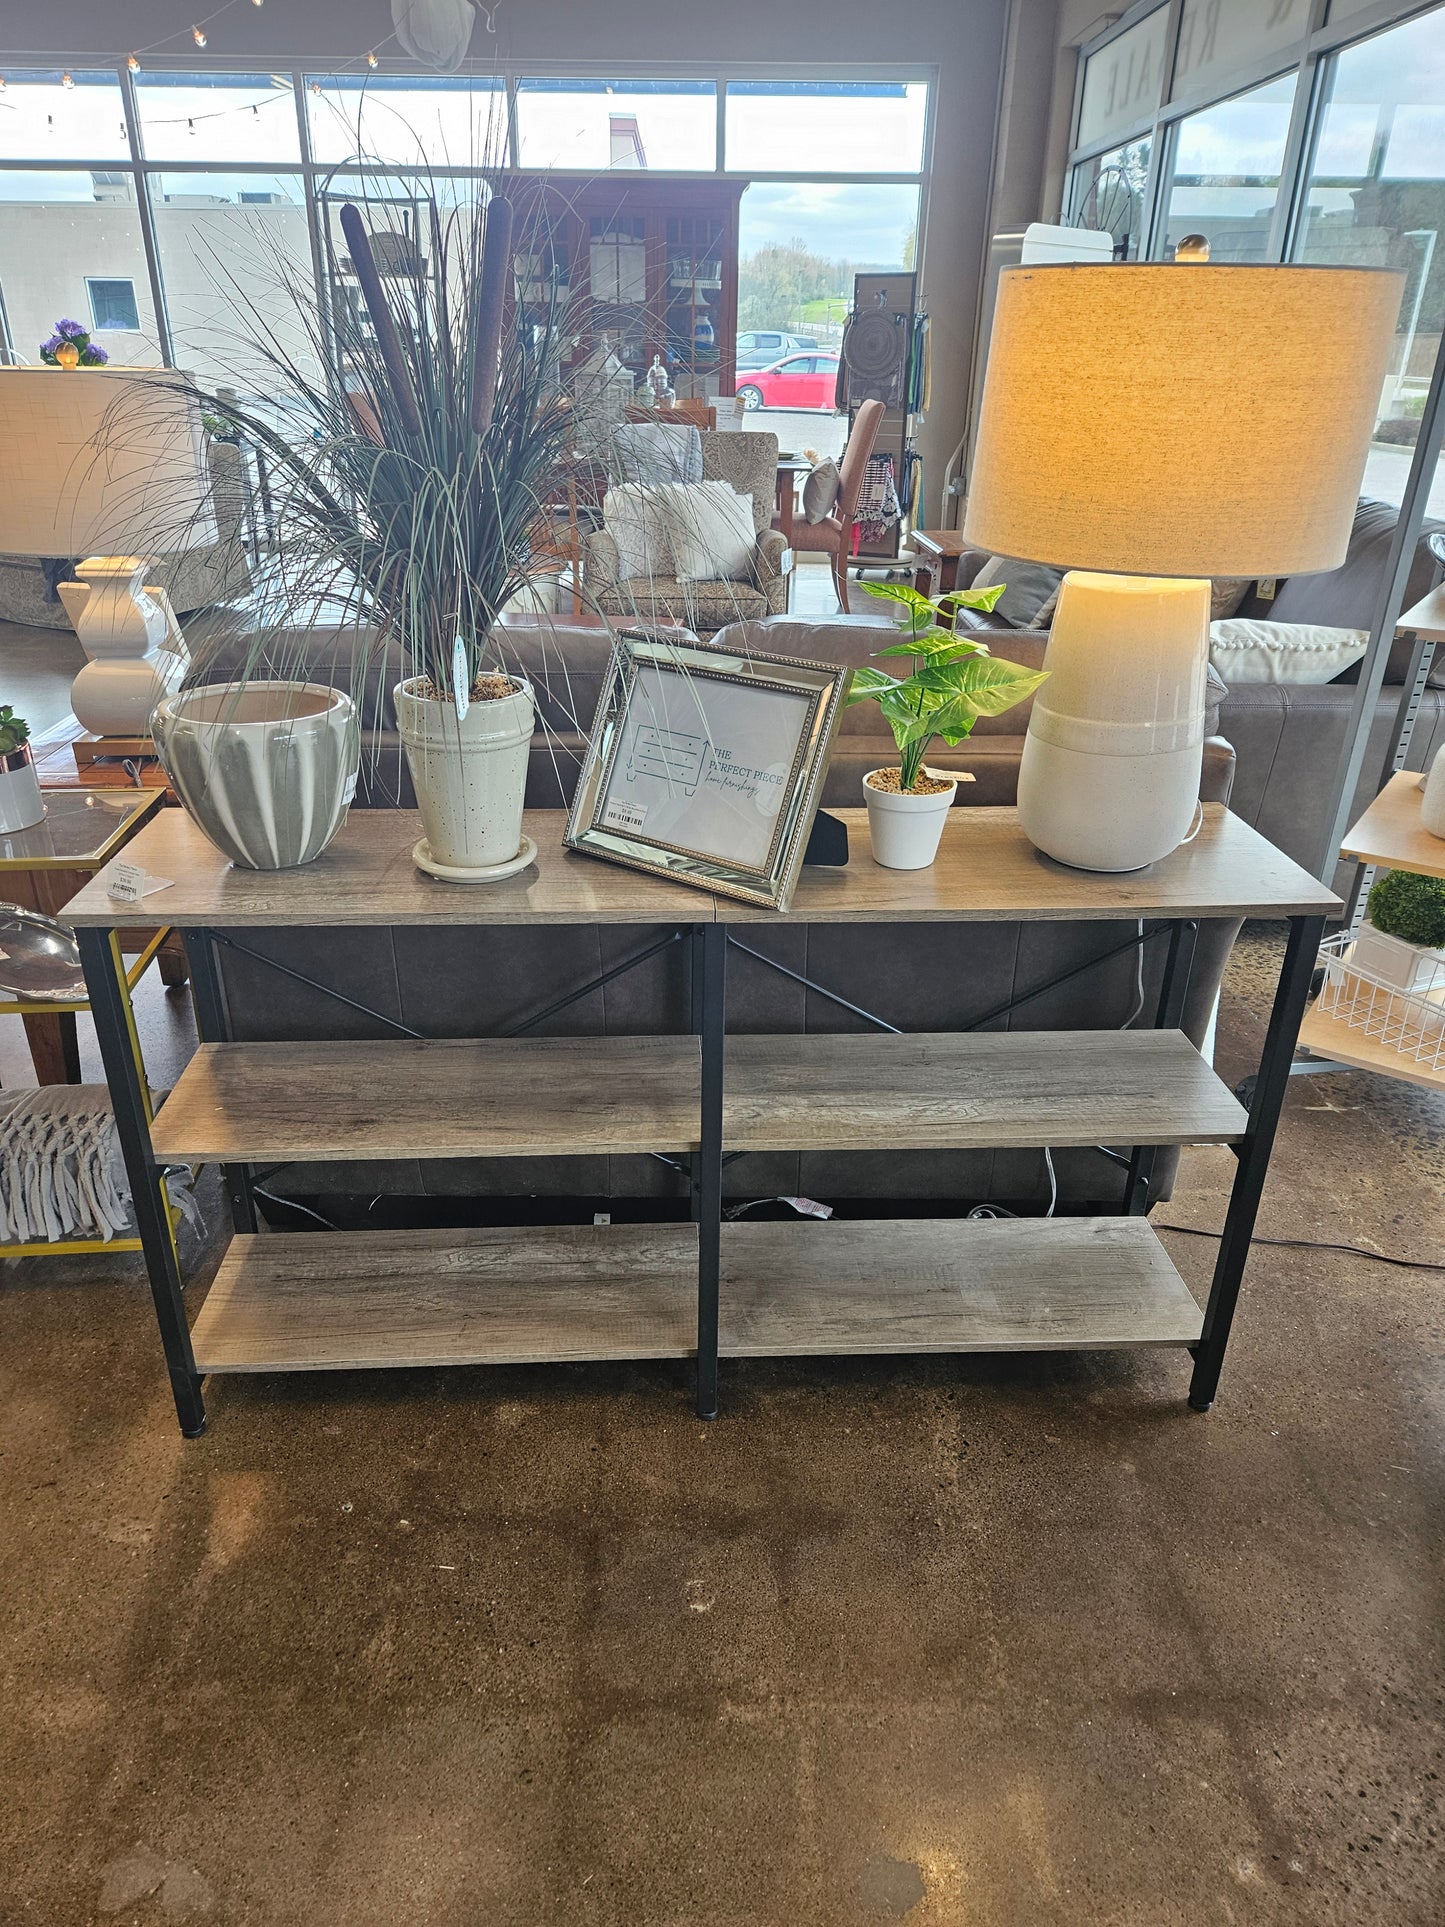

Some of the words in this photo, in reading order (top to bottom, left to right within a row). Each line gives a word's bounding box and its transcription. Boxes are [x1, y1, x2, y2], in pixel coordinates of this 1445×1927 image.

[712, 747, 732, 760] THE
[705, 771, 722, 783] home
[720, 777, 760, 798] furnishings
[708, 760, 753, 778] PERFECT
[753, 770, 784, 785] PIECE
